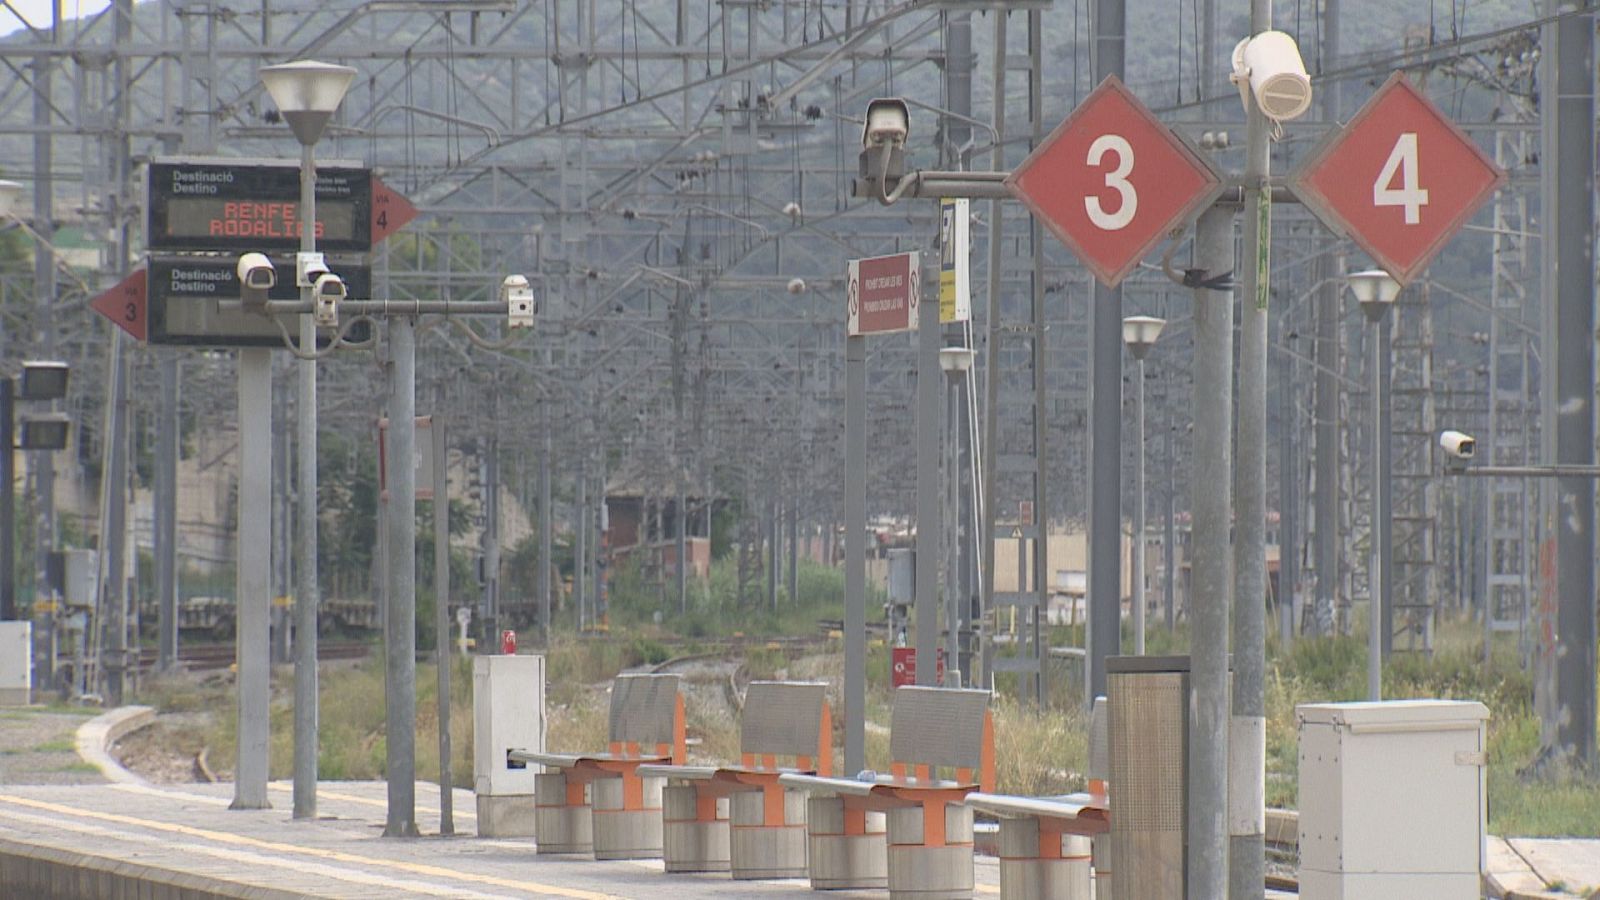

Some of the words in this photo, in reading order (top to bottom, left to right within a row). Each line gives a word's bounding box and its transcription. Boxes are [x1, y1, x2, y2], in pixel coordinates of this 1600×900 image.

[173, 169, 234, 182] Destinació
[1084, 134, 1138, 231] 3
[1373, 133, 1429, 225] 4
[173, 182, 217, 194] Destino
[224, 202, 296, 219] RENFE
[376, 210, 388, 230] 4
[171, 268, 232, 281] Destinació
[171, 281, 216, 292] Destino
[126, 302, 137, 322] 3
